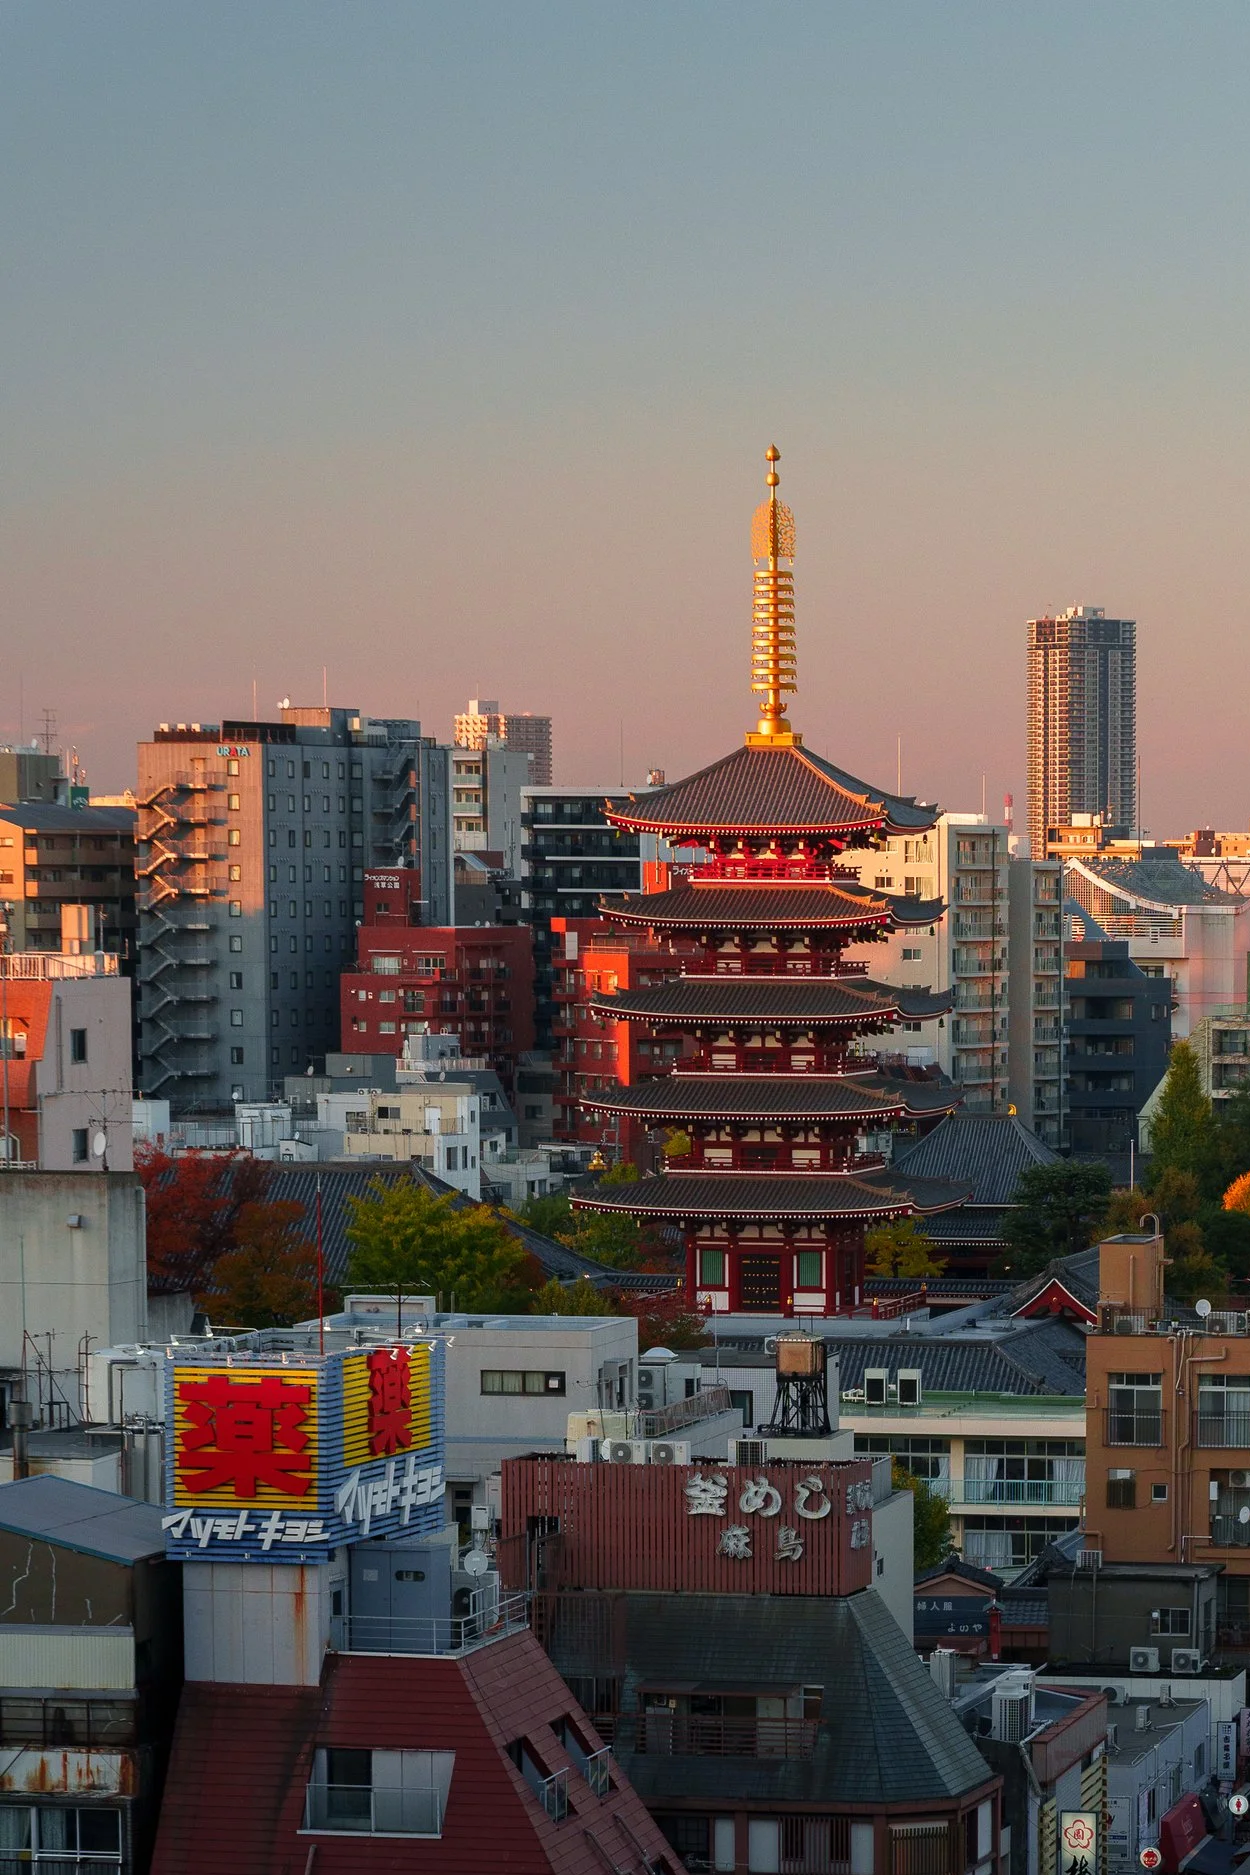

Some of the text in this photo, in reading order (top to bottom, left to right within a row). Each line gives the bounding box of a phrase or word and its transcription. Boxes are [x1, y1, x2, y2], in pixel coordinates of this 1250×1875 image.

[216, 746, 250, 757] URATA
[367, 1343, 413, 1455] 薬
[179, 1376, 312, 1498] 薬
[334, 1456, 446, 1534] マツモトキヨシ
[683, 1472, 832, 1520] 釜めし
[162, 1509, 331, 1550] マツモトキヨシ
[715, 1523, 804, 1562] 麻鳥
[916, 1601, 953, 1611] 婦人服
[947, 1622, 983, 1633] よのや
